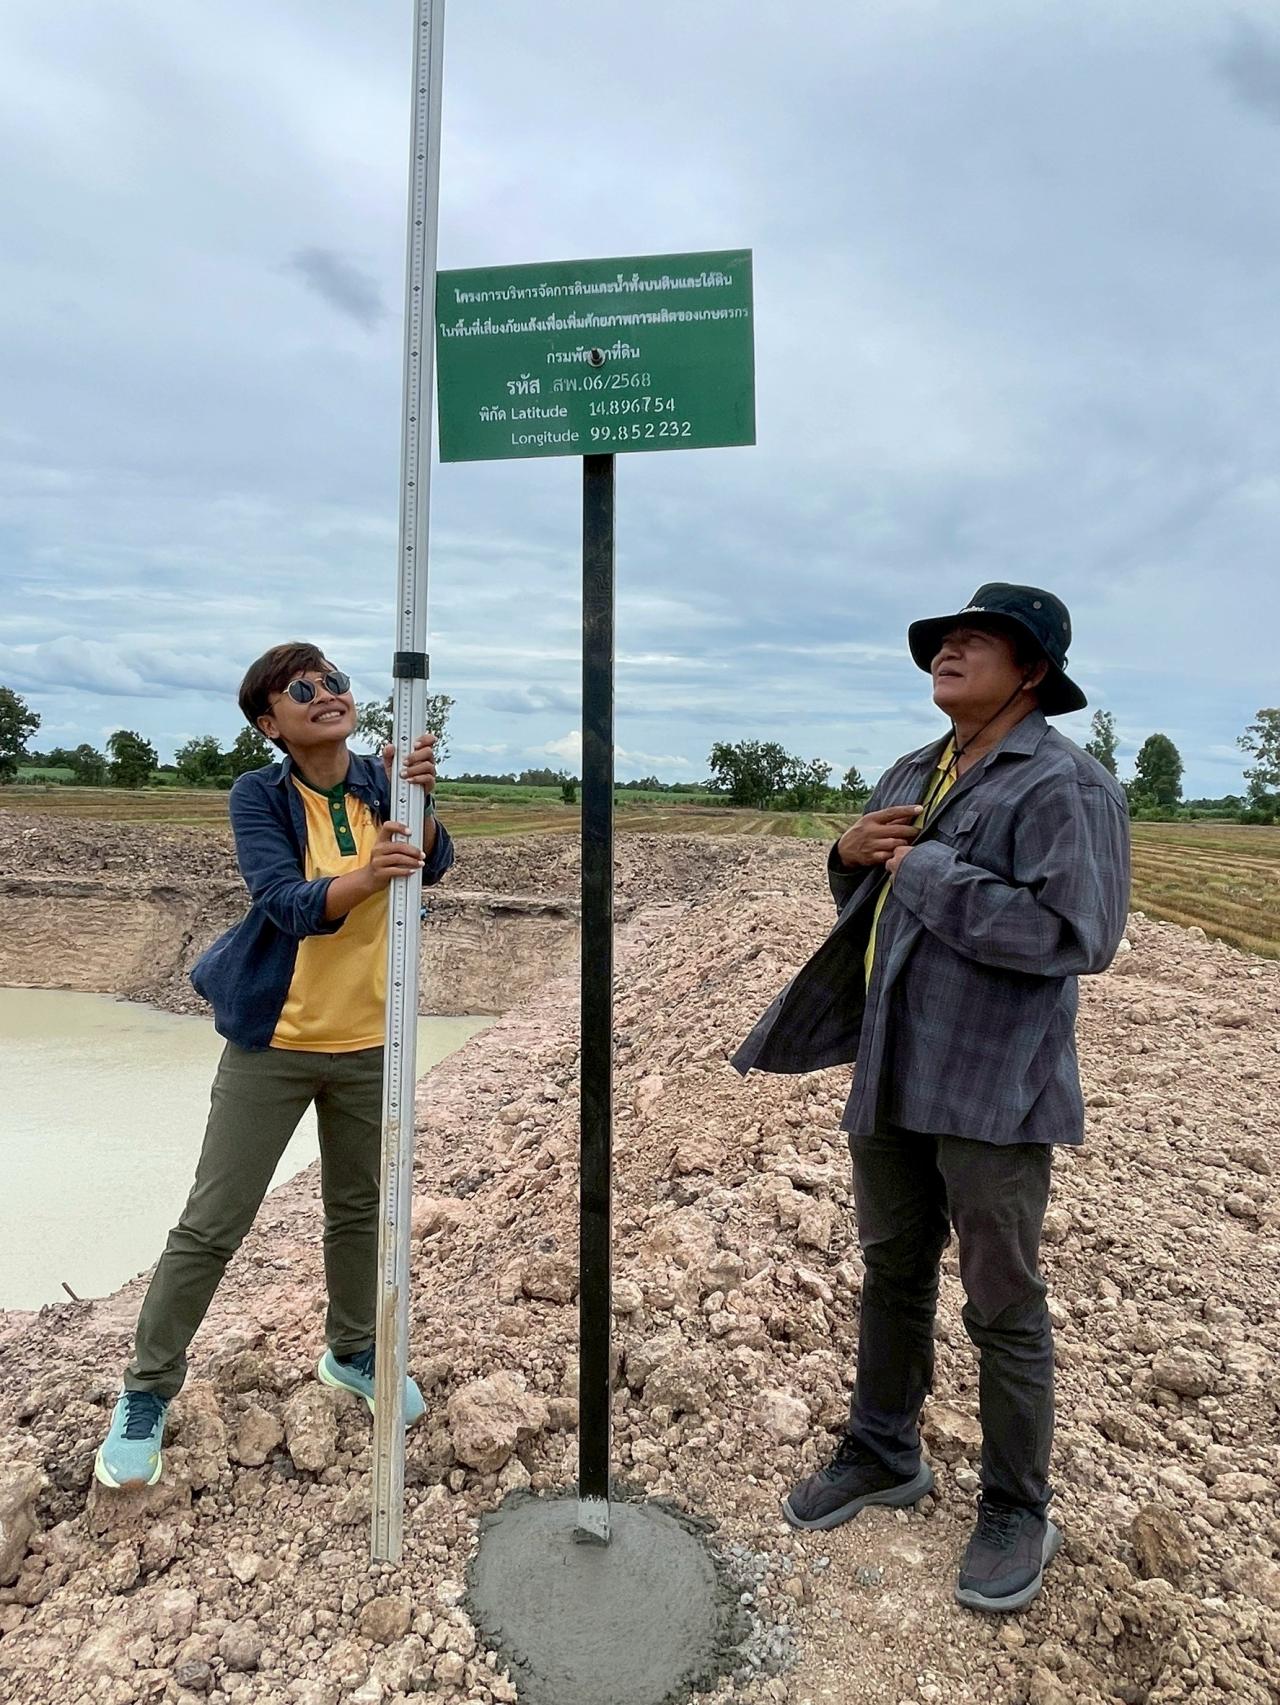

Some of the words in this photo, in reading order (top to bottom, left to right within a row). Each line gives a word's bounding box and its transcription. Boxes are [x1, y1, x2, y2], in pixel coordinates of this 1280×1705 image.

[506, 373, 540, 395] รหัส
[479, 405, 506, 421] พิกัด
[511, 405, 568, 419] Latitude
[589, 397, 675, 416] 14.896754
[512, 430, 579, 446] Longitude
